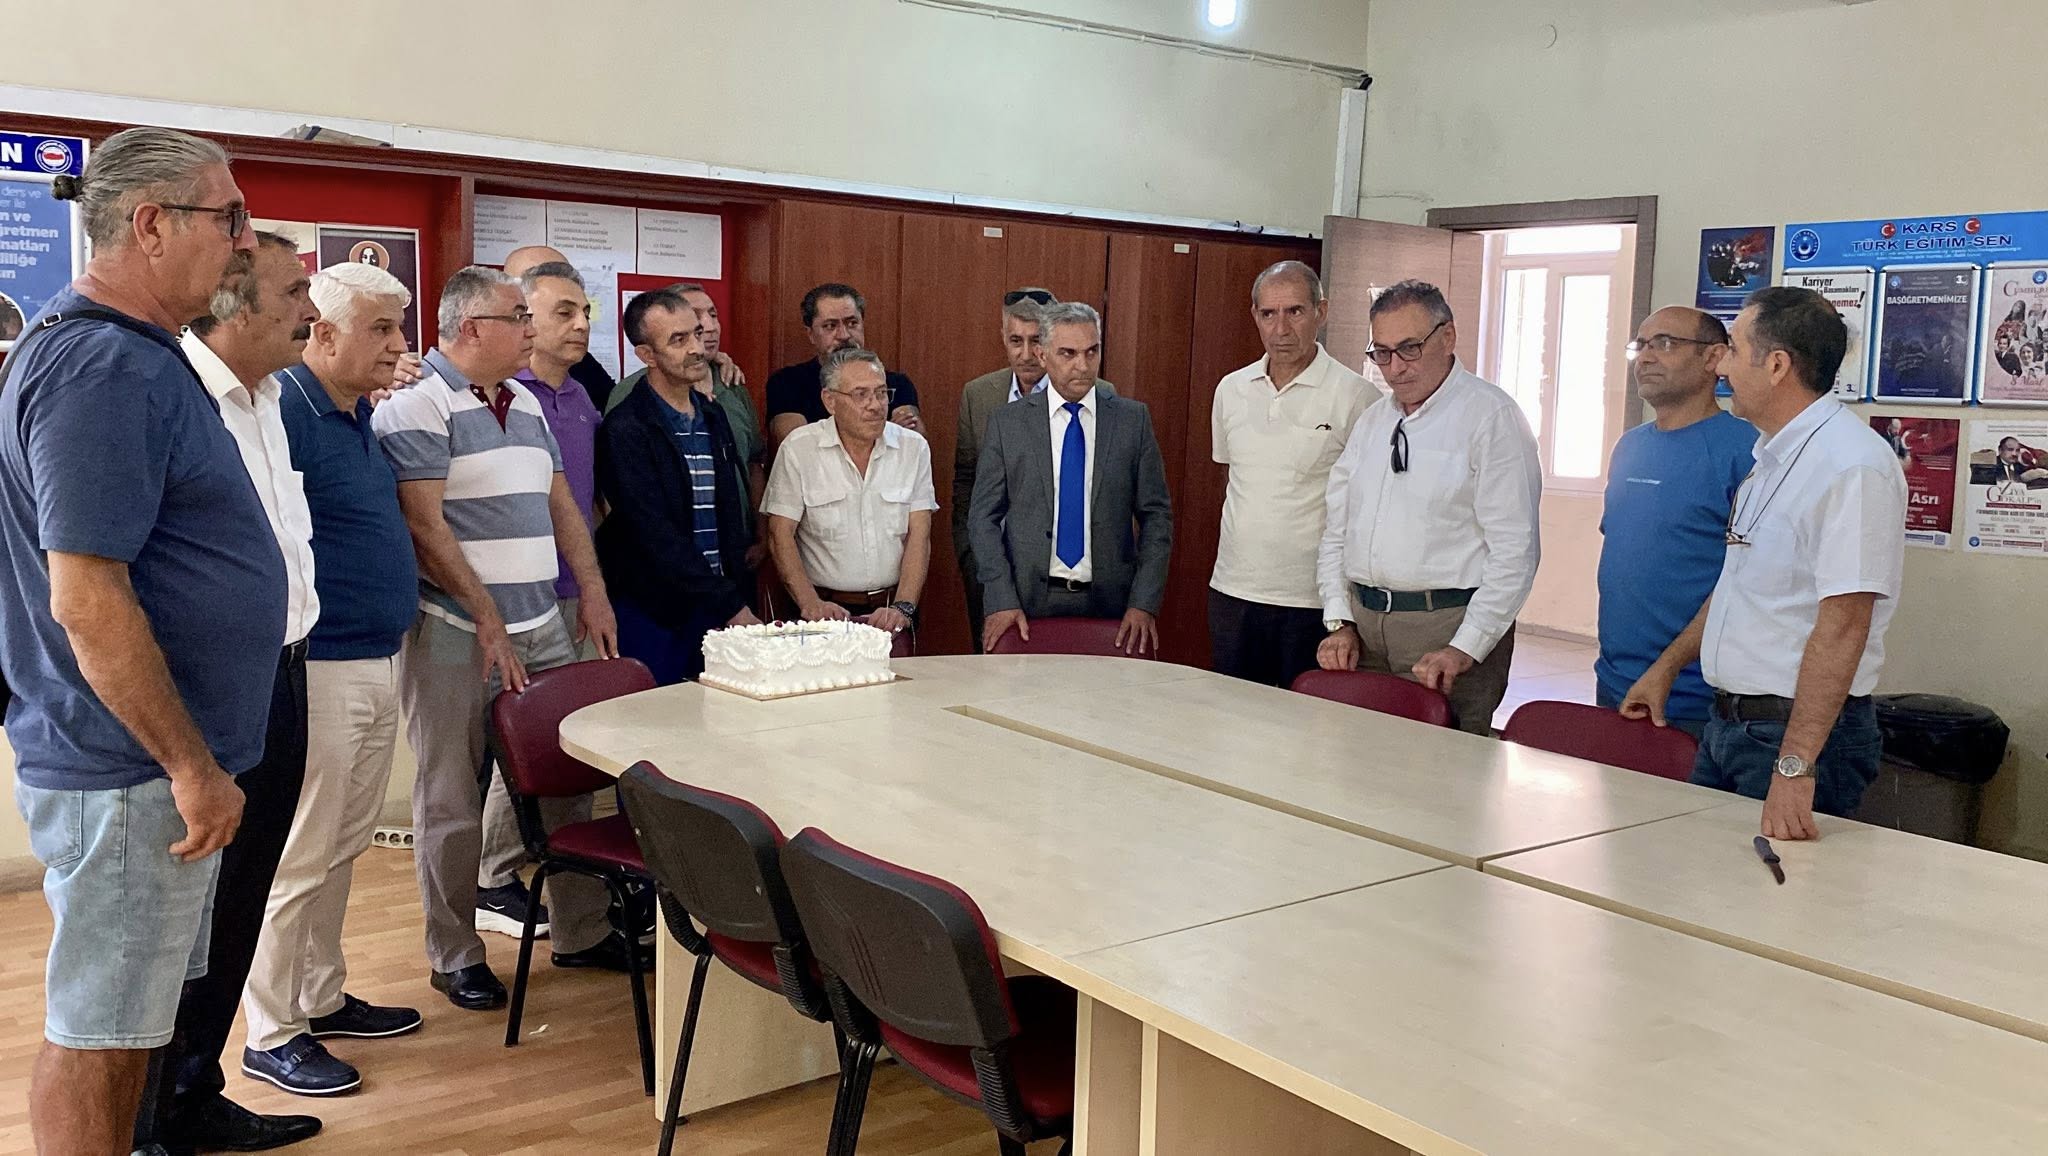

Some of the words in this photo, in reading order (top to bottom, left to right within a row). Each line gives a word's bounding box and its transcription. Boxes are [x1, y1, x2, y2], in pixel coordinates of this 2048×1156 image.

[27, 190, 42, 199] ve
[12, 212, 32, 222] ve
[1902, 221, 1957, 234] KARS
[1852, 238, 1899, 251] TÜRK
[1900, 234, 2012, 250] EĞİTİM-SEN
[1802, 276, 1833, 288] Kariyer
